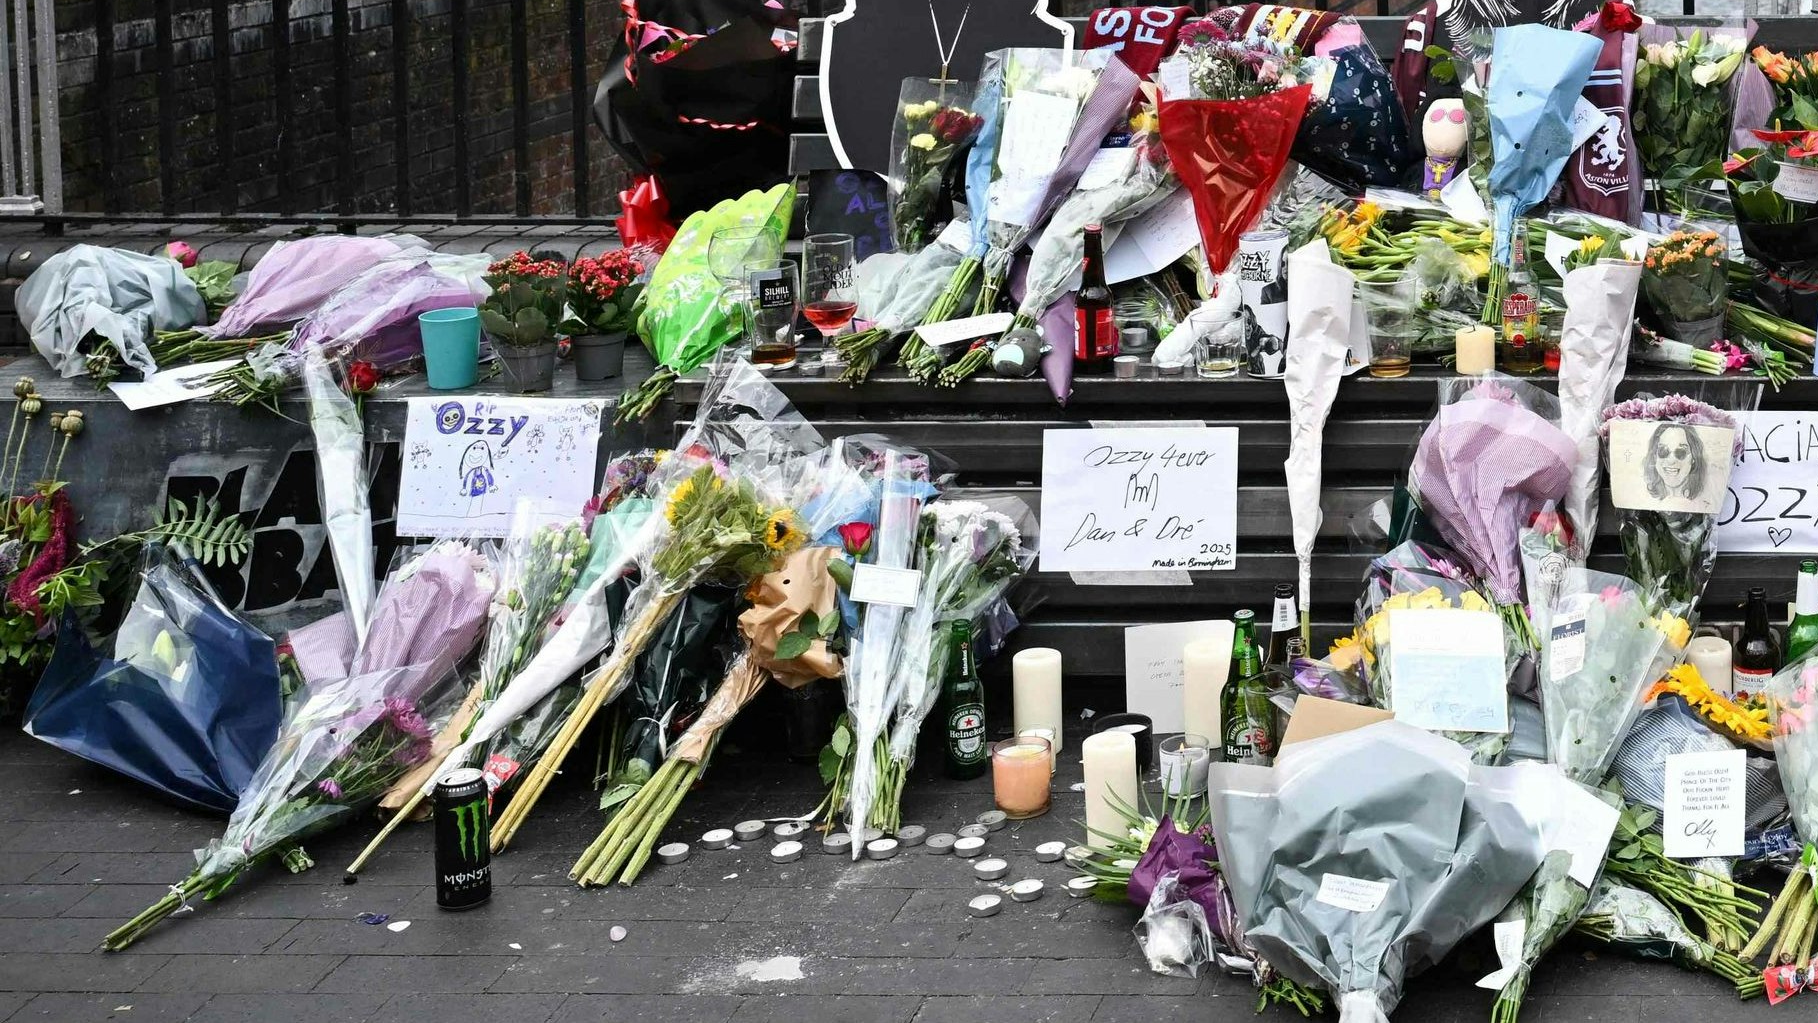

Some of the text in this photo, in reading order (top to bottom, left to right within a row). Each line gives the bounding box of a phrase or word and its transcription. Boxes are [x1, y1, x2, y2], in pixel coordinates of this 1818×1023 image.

[1585, 173, 1609, 185] ASTON
[1241, 251, 1270, 271] ZZY
[765, 286, 789, 296] SILHILL
[823, 280, 854, 290] CIDER
[1161, 443, 1216, 468] 4ever
[1064, 513, 1116, 551] Dan
[1124, 519, 1147, 537] &
[1200, 544, 1232, 555] 2025
[1177, 557, 1186, 567] in
[1188, 555, 1232, 571] Birmingham
[950, 726, 986, 738] Heineken
[444, 864, 495, 886] MONST
